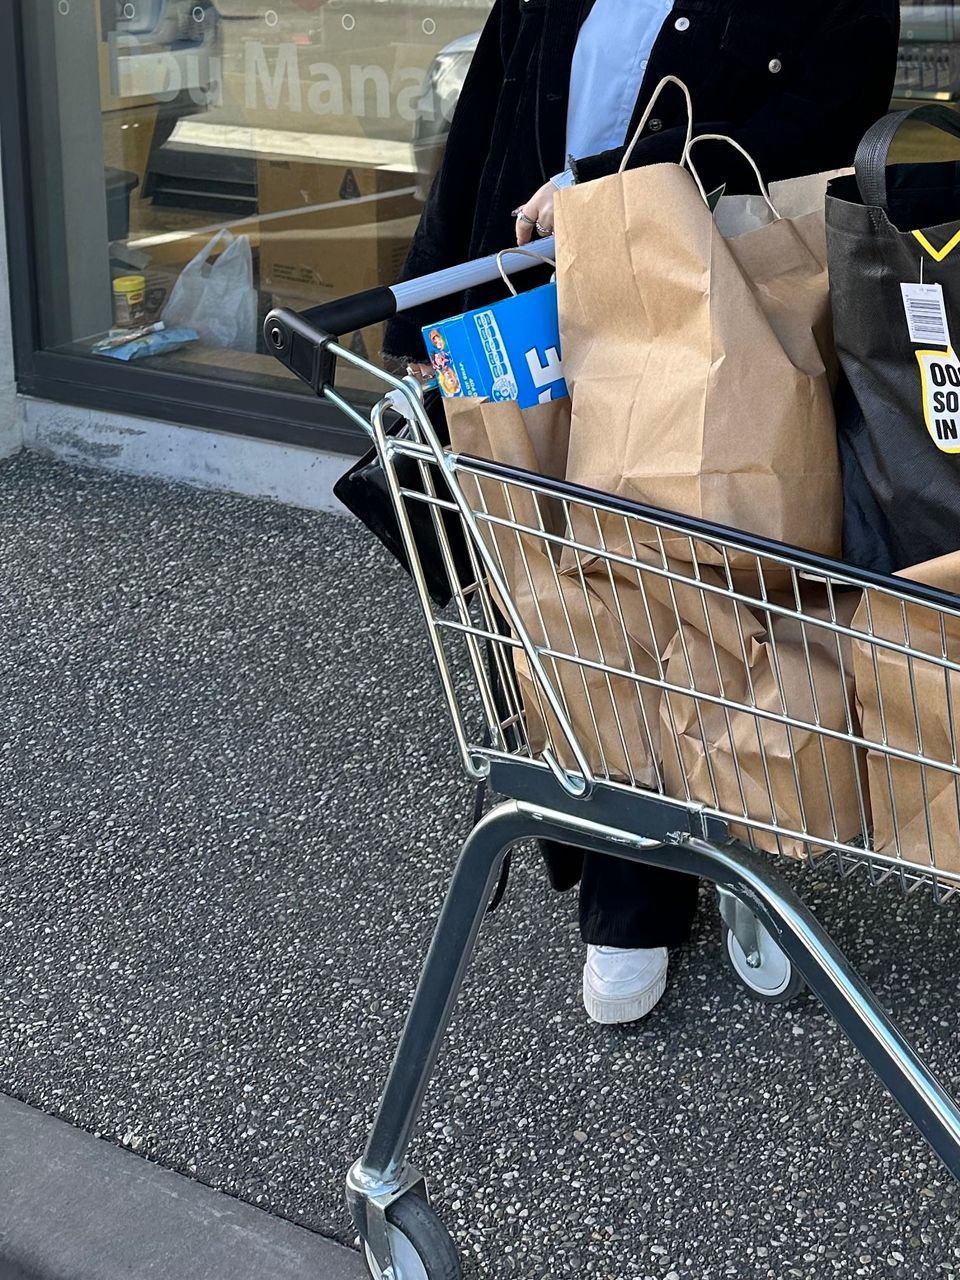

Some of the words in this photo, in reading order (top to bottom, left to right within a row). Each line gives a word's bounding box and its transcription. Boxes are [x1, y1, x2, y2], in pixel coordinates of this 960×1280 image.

[244, 40, 455, 124] Mana
[933, 391, 959, 413] SO
[934, 419, 958, 440] IN
